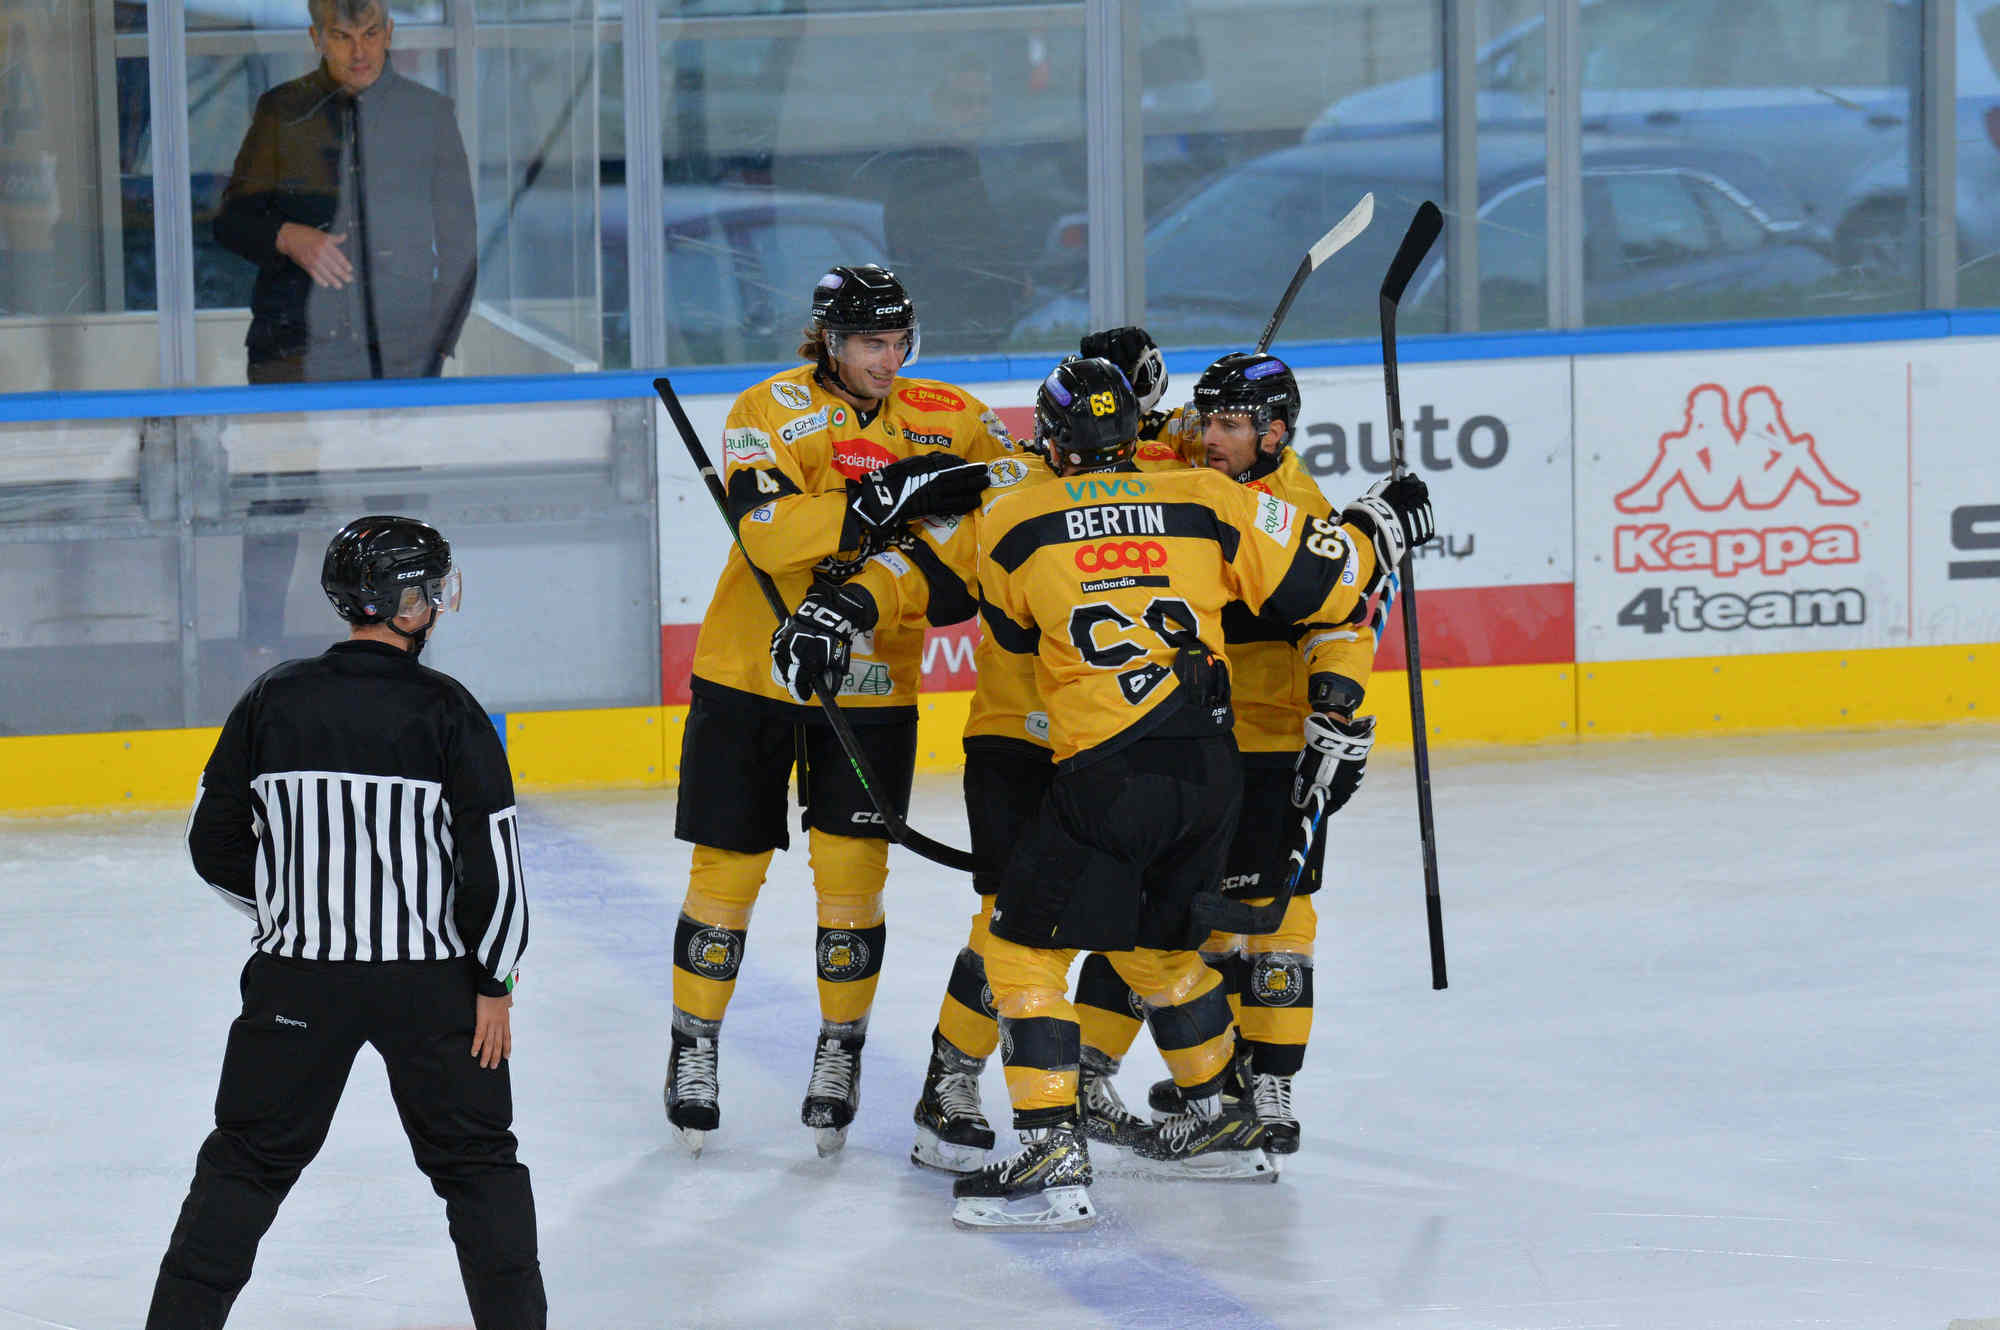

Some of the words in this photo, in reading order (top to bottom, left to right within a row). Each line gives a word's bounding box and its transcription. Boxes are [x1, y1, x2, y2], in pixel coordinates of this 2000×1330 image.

[875, 305, 903, 315] CCM
[1089, 391, 1117, 417] 69
[1197, 387, 1221, 396] CCM
[1266, 393, 1288, 403] CCM
[1304, 404, 1510, 476] auto
[755, 469, 780, 494] 4
[1065, 504, 1166, 540] BERTIN
[1306, 518, 1347, 560] 69
[1614, 523, 1861, 577] Kappa
[396, 569, 425, 580] CCM
[1082, 577, 1136, 593] Lombardia
[1617, 586, 1866, 634] 4team
